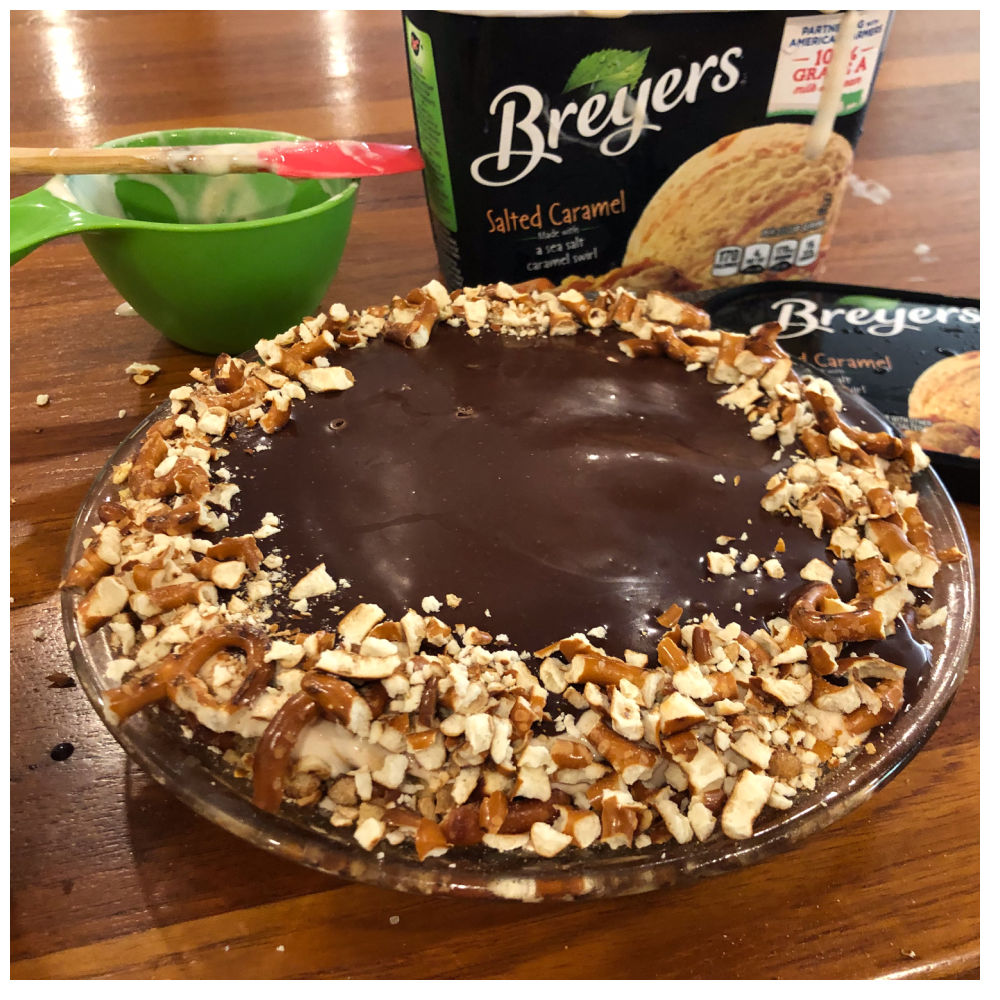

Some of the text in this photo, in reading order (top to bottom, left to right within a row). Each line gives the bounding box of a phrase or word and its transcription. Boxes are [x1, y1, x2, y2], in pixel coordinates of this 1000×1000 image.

[789, 35, 836, 47] AMERICA
[470, 47, 743, 186] Breyers
[486, 189, 626, 234] Salted Caramel
[535, 236, 584, 255] a sea salt
[537, 230, 559, 240] Made
[526, 247, 598, 271] caramel swirl
[751, 298, 980, 339] Breyers
[813, 352, 893, 372] Caramel
